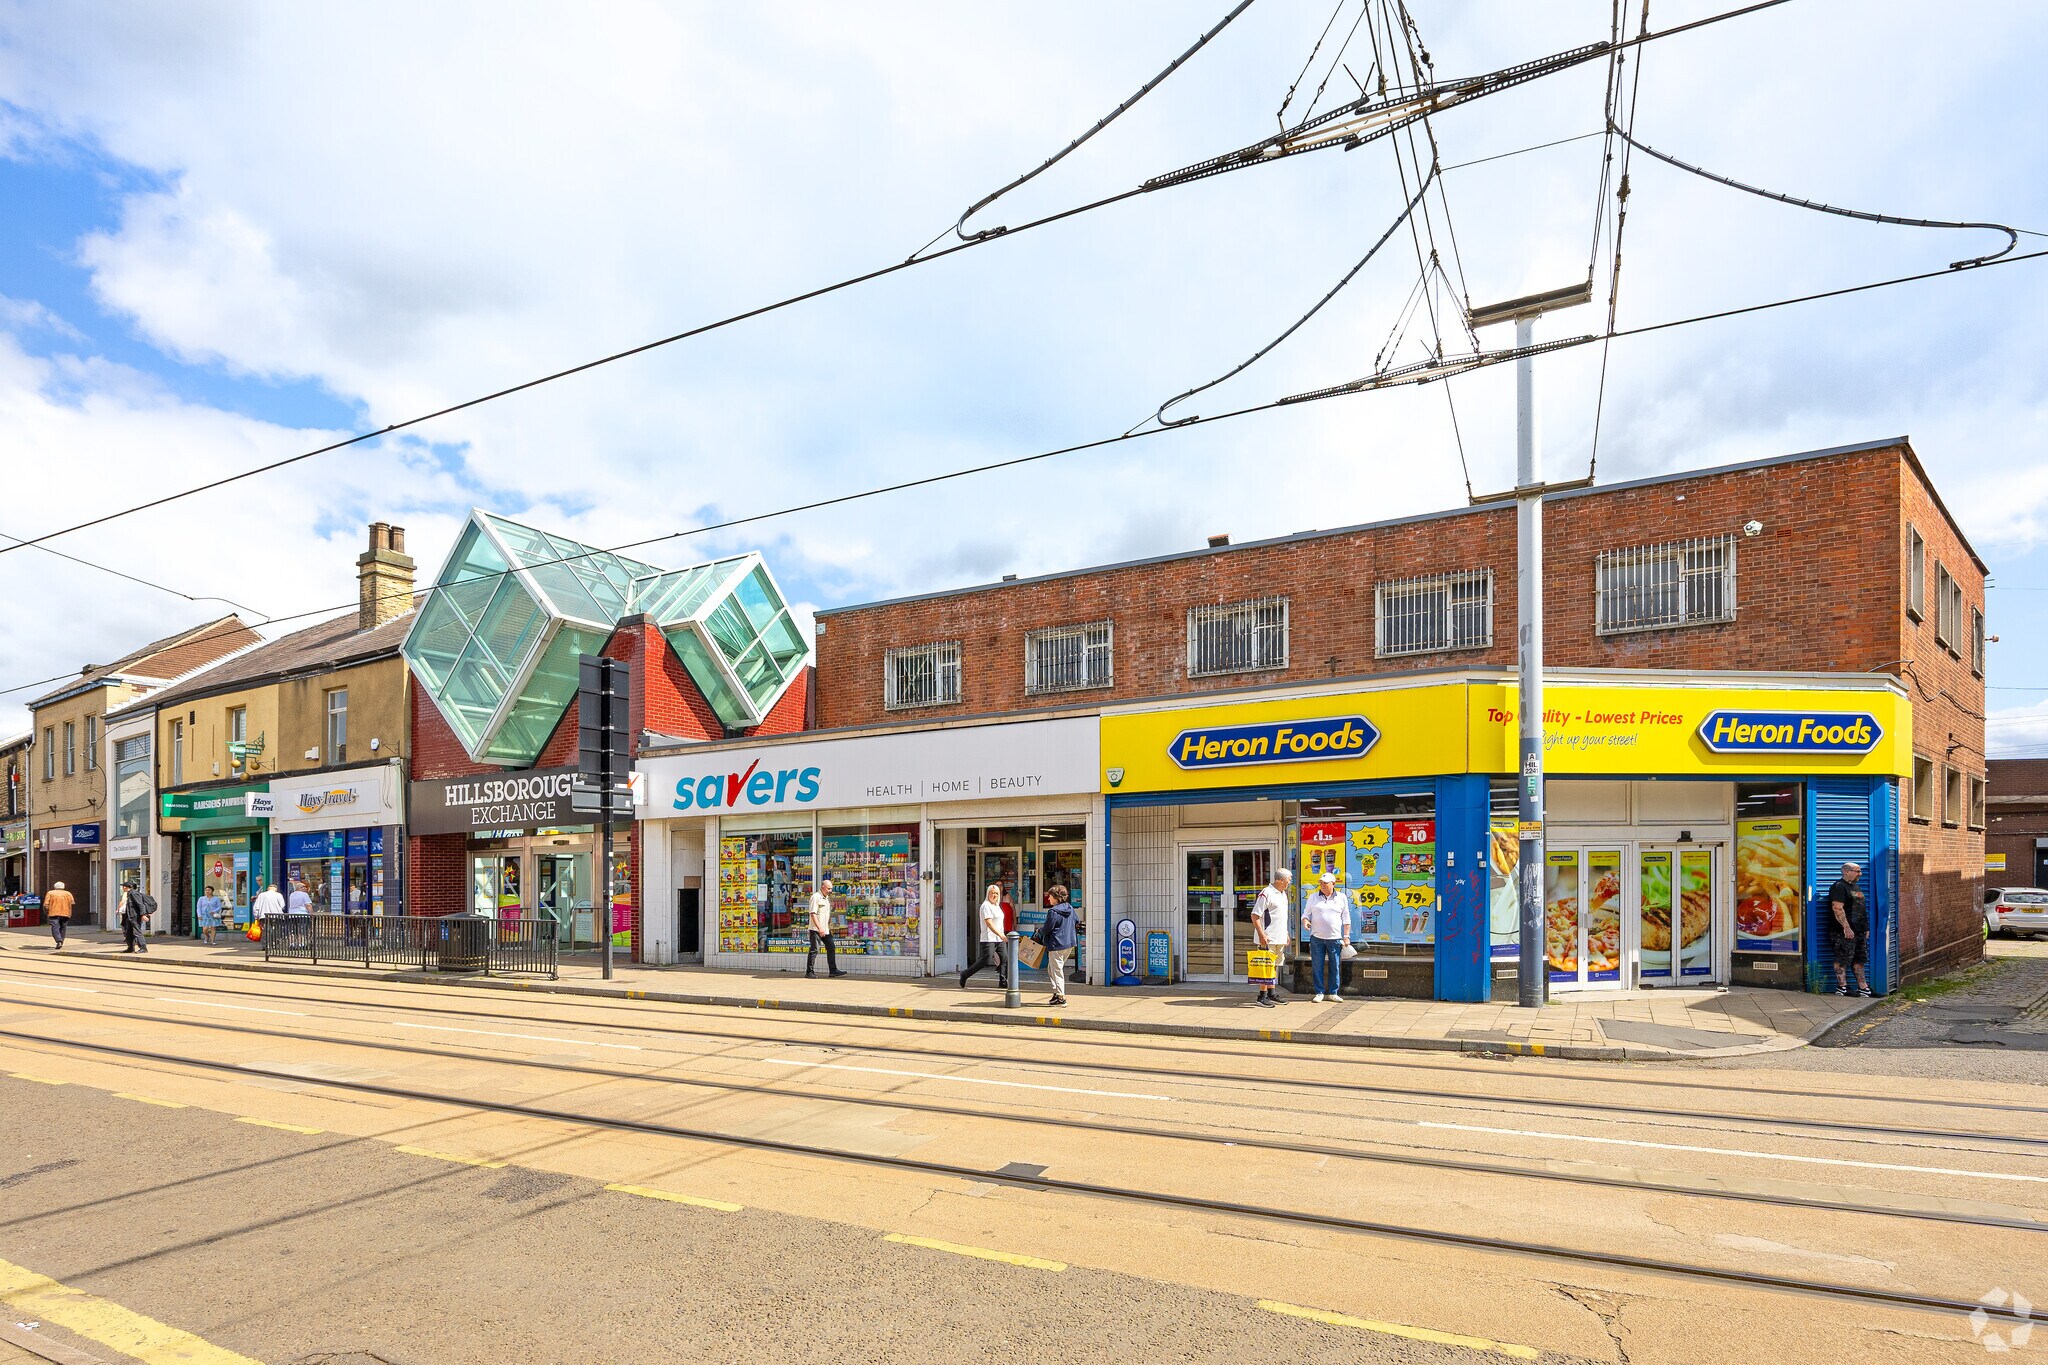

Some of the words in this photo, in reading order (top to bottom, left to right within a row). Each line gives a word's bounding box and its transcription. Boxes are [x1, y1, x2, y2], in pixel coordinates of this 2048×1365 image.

[1487, 708, 1513, 726] Top
[1585, 710, 1635, 724] Lowest
[1640, 710, 1683, 725] Prices
[1713, 718, 1794, 744] Heron
[1797, 718, 1872, 744] Foods
[1181, 735, 1269, 761] Heron
[1273, 722, 1363, 754] Foods
[1567, 736, 1580, 750] up
[1580, 735, 1606, 750] your
[1608, 732, 1638, 746] street!
[673, 757, 821, 810] savers
[866, 784, 913, 797] HEALTH
[932, 780, 969, 792] HOME
[990, 776, 1042, 789] BEAUTY
[194, 799, 221, 810] RAMSDENS
[253, 798, 271, 806] Hays
[300, 793, 321, 809] Hays
[324, 789, 353, 805] Travel
[471, 801, 556, 825] EXCHANGE
[1313, 829, 1332, 841] £1.25
[1363, 834, 1375, 845] £2
[1407, 830, 1427, 842] £10
[865, 839, 894, 848] savers
[1150, 938, 1167, 946] FREE
[1150, 946, 1167, 954] CASH
[1150, 958, 1167, 966] HERE
